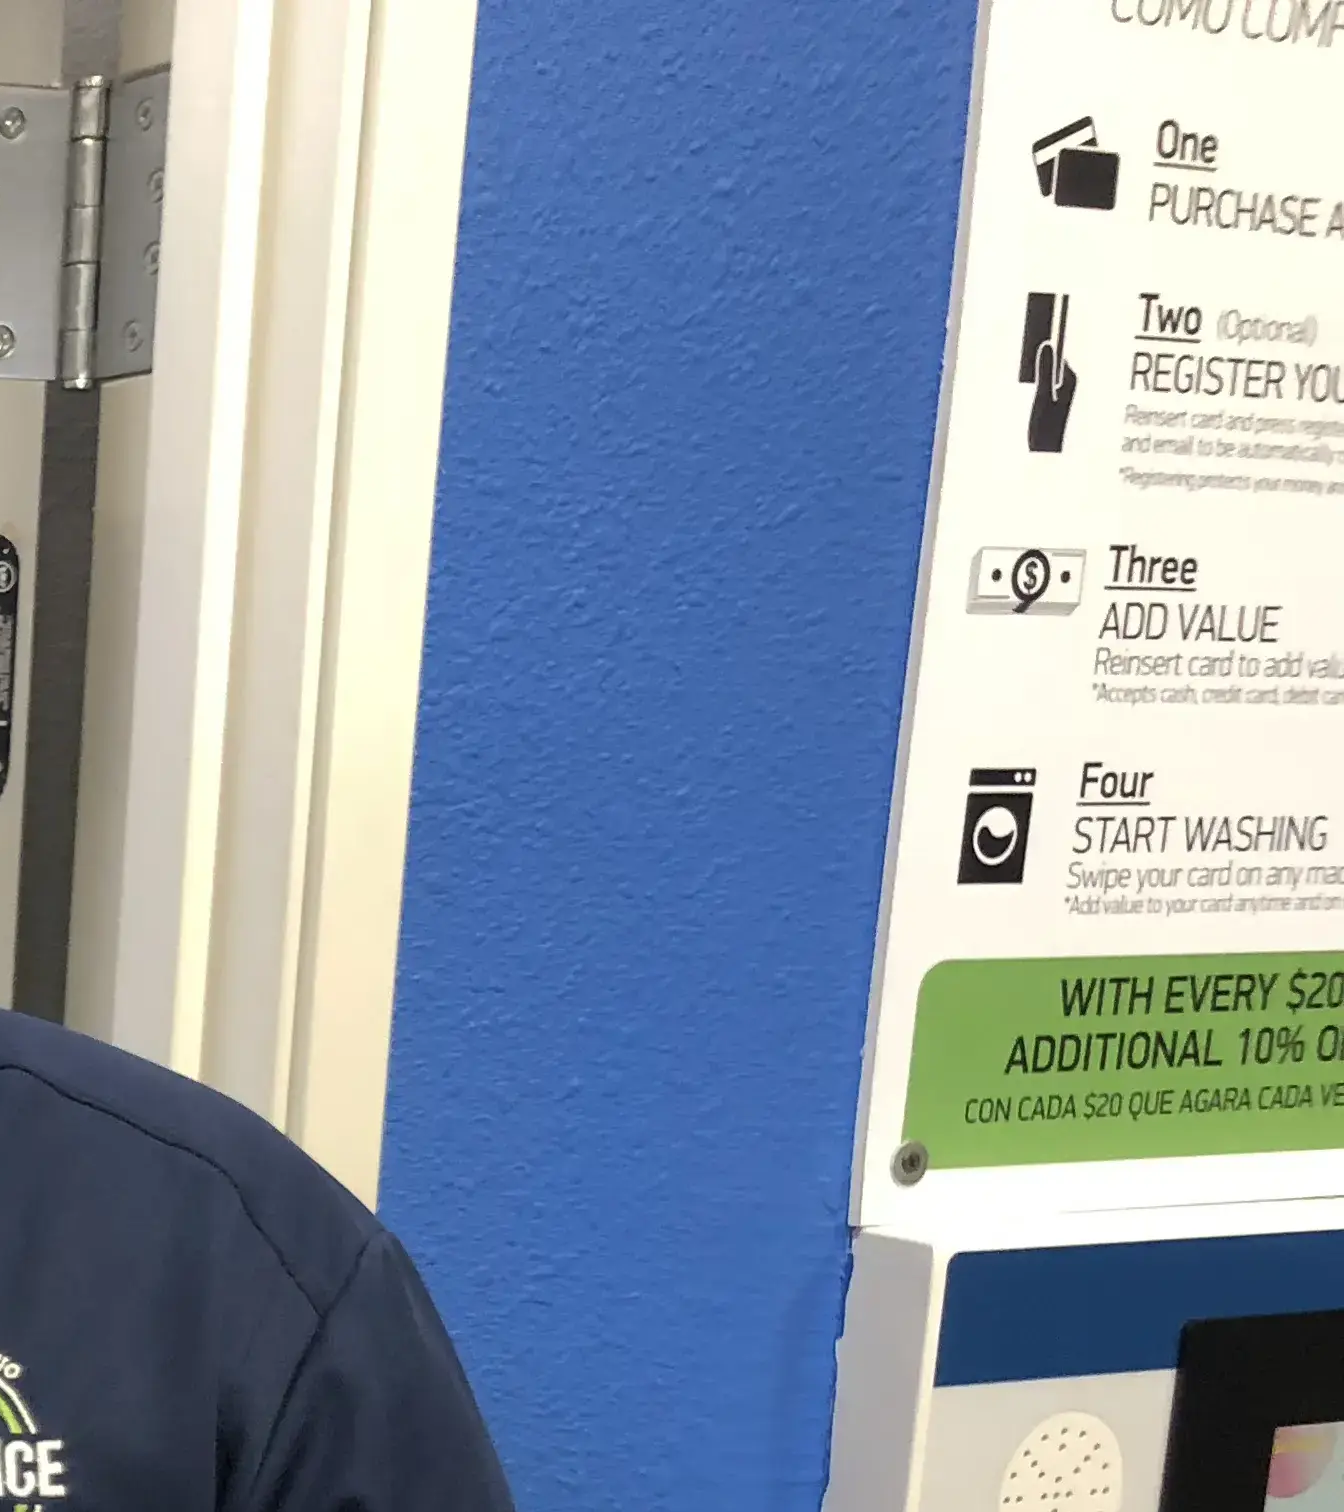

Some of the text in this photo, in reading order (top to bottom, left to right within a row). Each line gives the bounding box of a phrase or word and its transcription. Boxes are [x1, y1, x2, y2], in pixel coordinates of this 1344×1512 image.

[1157, 119, 1218, 163] One
[1149, 182, 1321, 237] PURCHASE
[1138, 293, 1318, 347] Two (Optional)
[1130, 351, 1285, 399] REGISTER
[1110, 544, 1198, 584] Three
[1099, 602, 1283, 642] ADD VALUE
[1093, 647, 1183, 676] Reinsert
[1188, 649, 1235, 677] card
[1237, 654, 1260, 677] to
[1263, 650, 1304, 678] add
[1080, 762, 1153, 798] Four
[1073, 815, 1329, 853] START WASHING
[1066, 861, 1131, 894] Swipe
[1136, 867, 1183, 893] your
[1187, 860, 1233, 887] card
[1236, 866, 1261, 886] on
[1265, 866, 1303, 891] any
[1061, 967, 1344, 1017] WITH EVERY $20
[1004, 1028, 1223, 1075] ADDITIONAL
[1239, 1025, 1305, 1065] 10%
[965, 1097, 1011, 1123] CON
[1018, 1094, 1076, 1121] CADA
[1083, 1090, 1121, 1121] $20
[1128, 1089, 1174, 1121] QUE
[1179, 1086, 1251, 1114] AGARA
[1257, 1084, 1312, 1111] CADA
